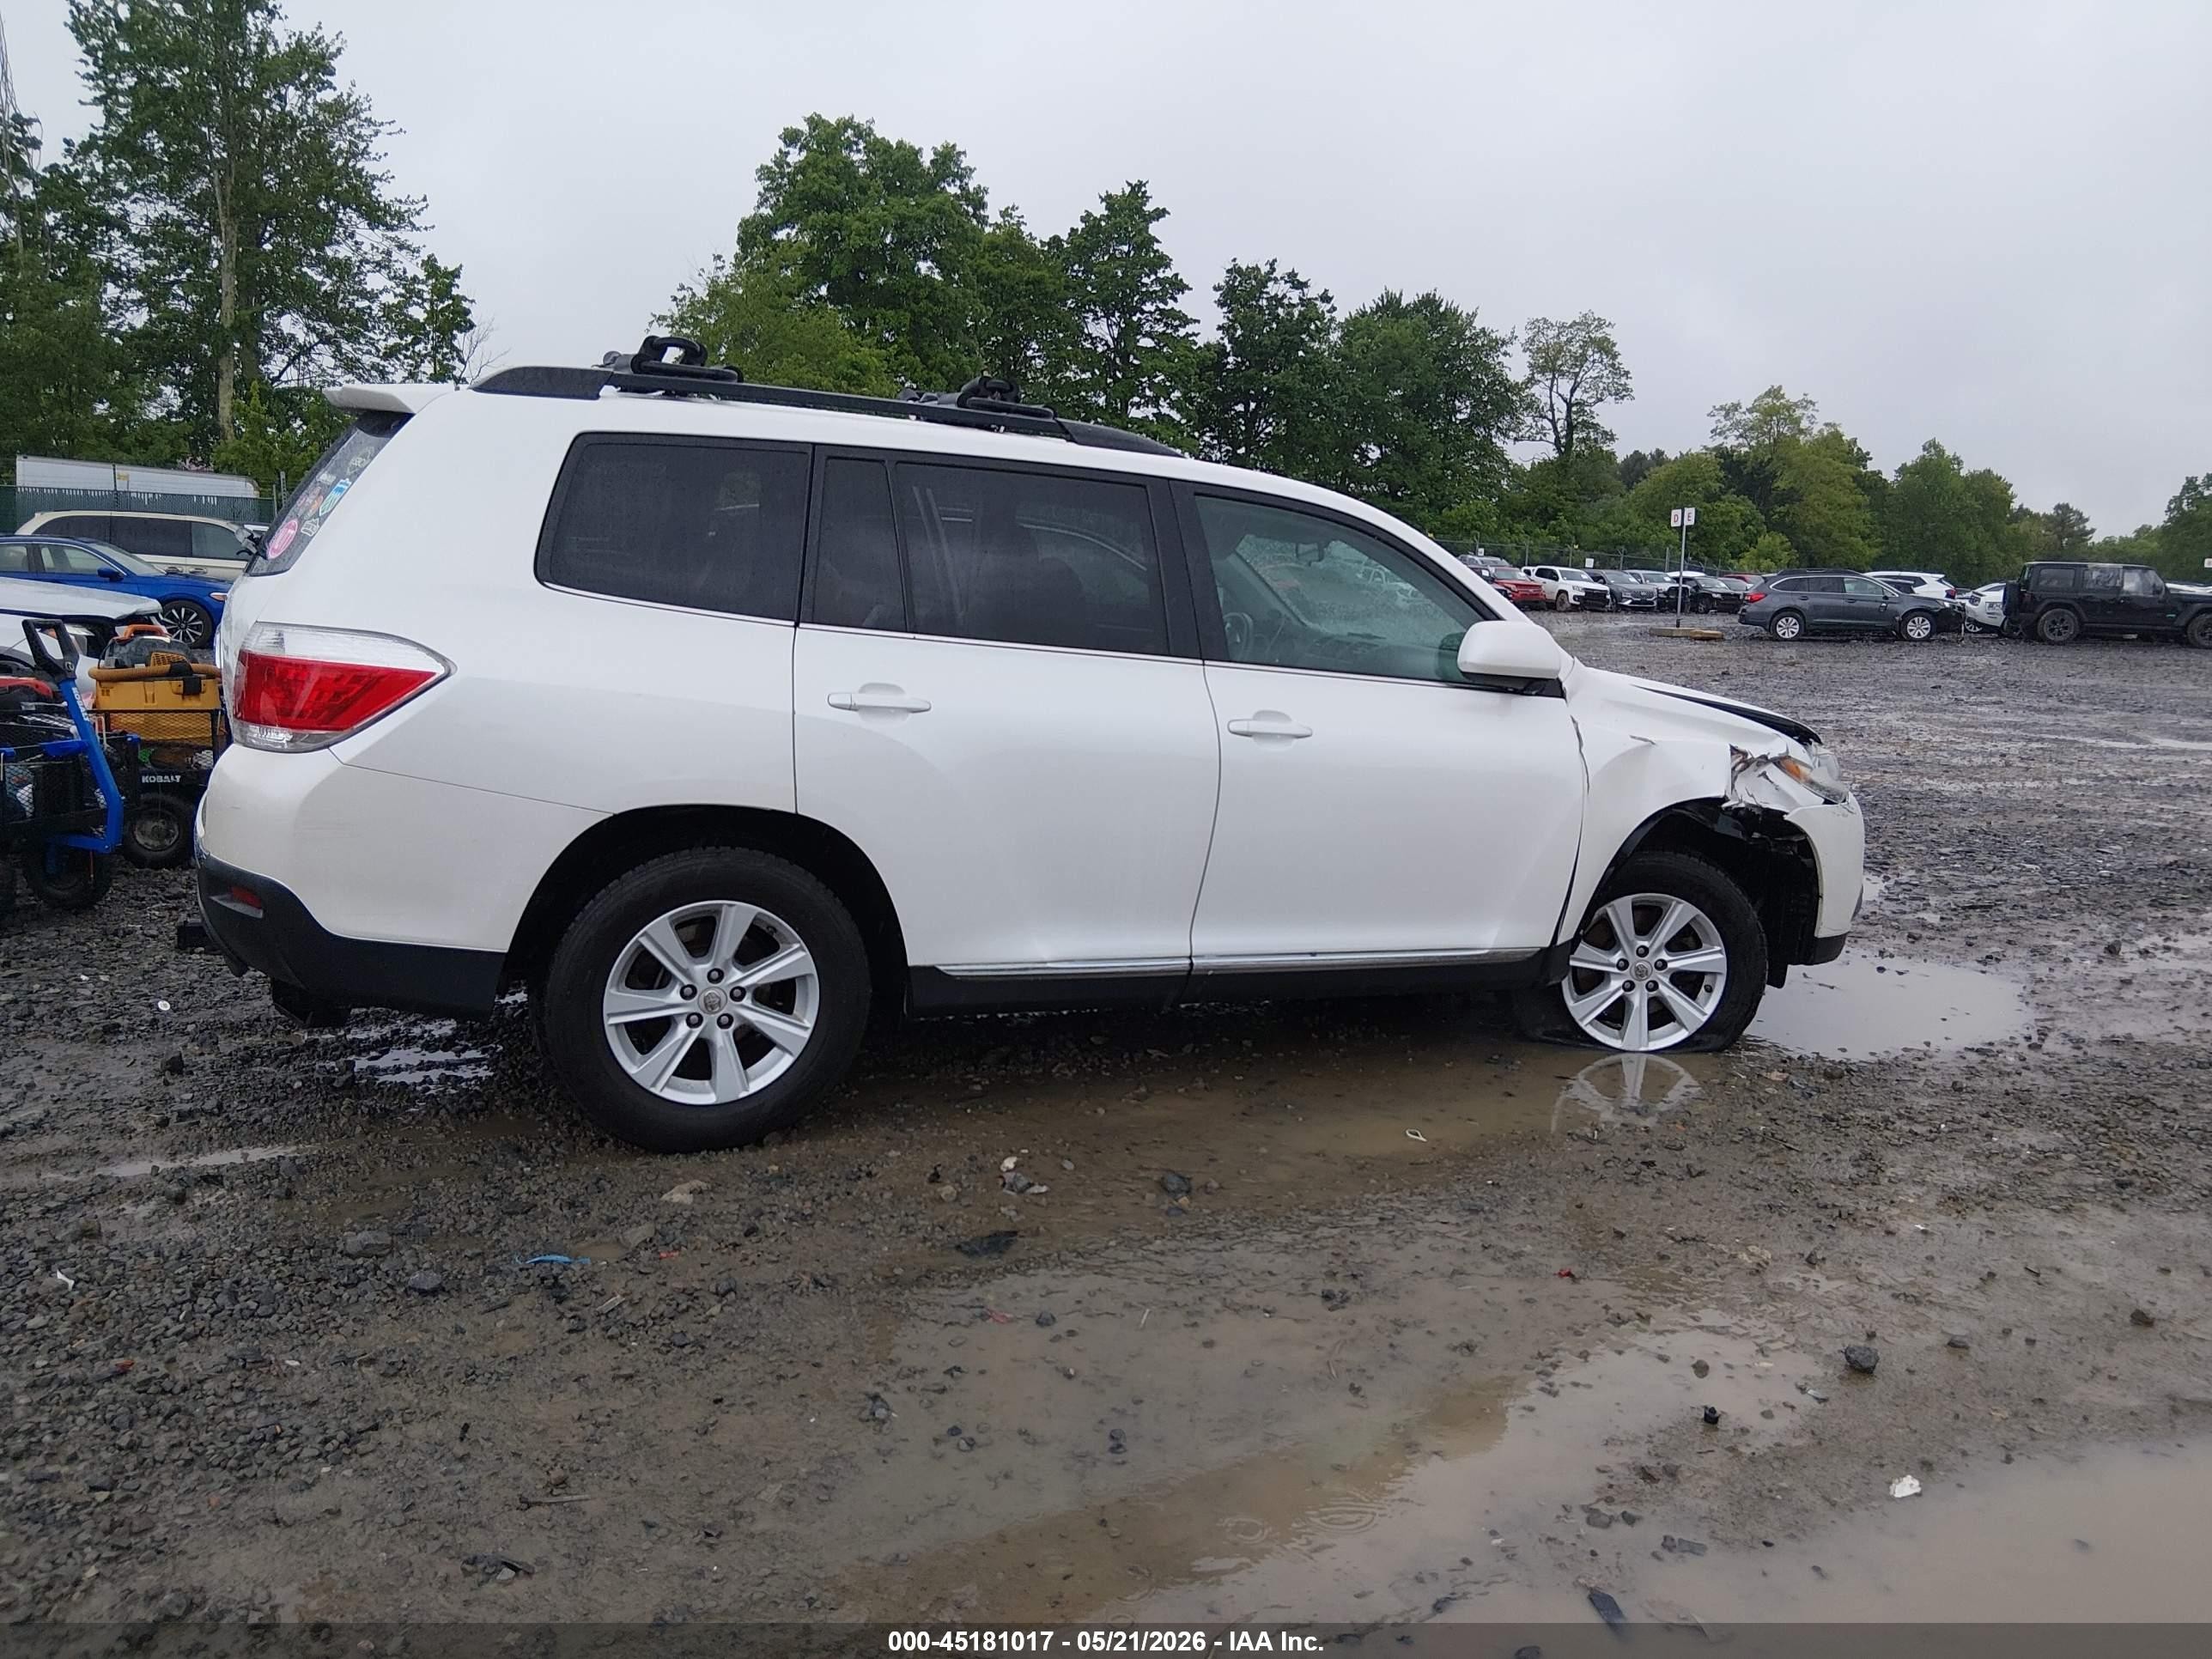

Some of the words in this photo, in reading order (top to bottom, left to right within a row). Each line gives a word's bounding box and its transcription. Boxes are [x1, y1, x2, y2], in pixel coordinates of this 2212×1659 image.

[1674, 514, 1679, 523] D
[1687, 513, 1692, 521] E
[142, 775, 181, 783] KOBALT
